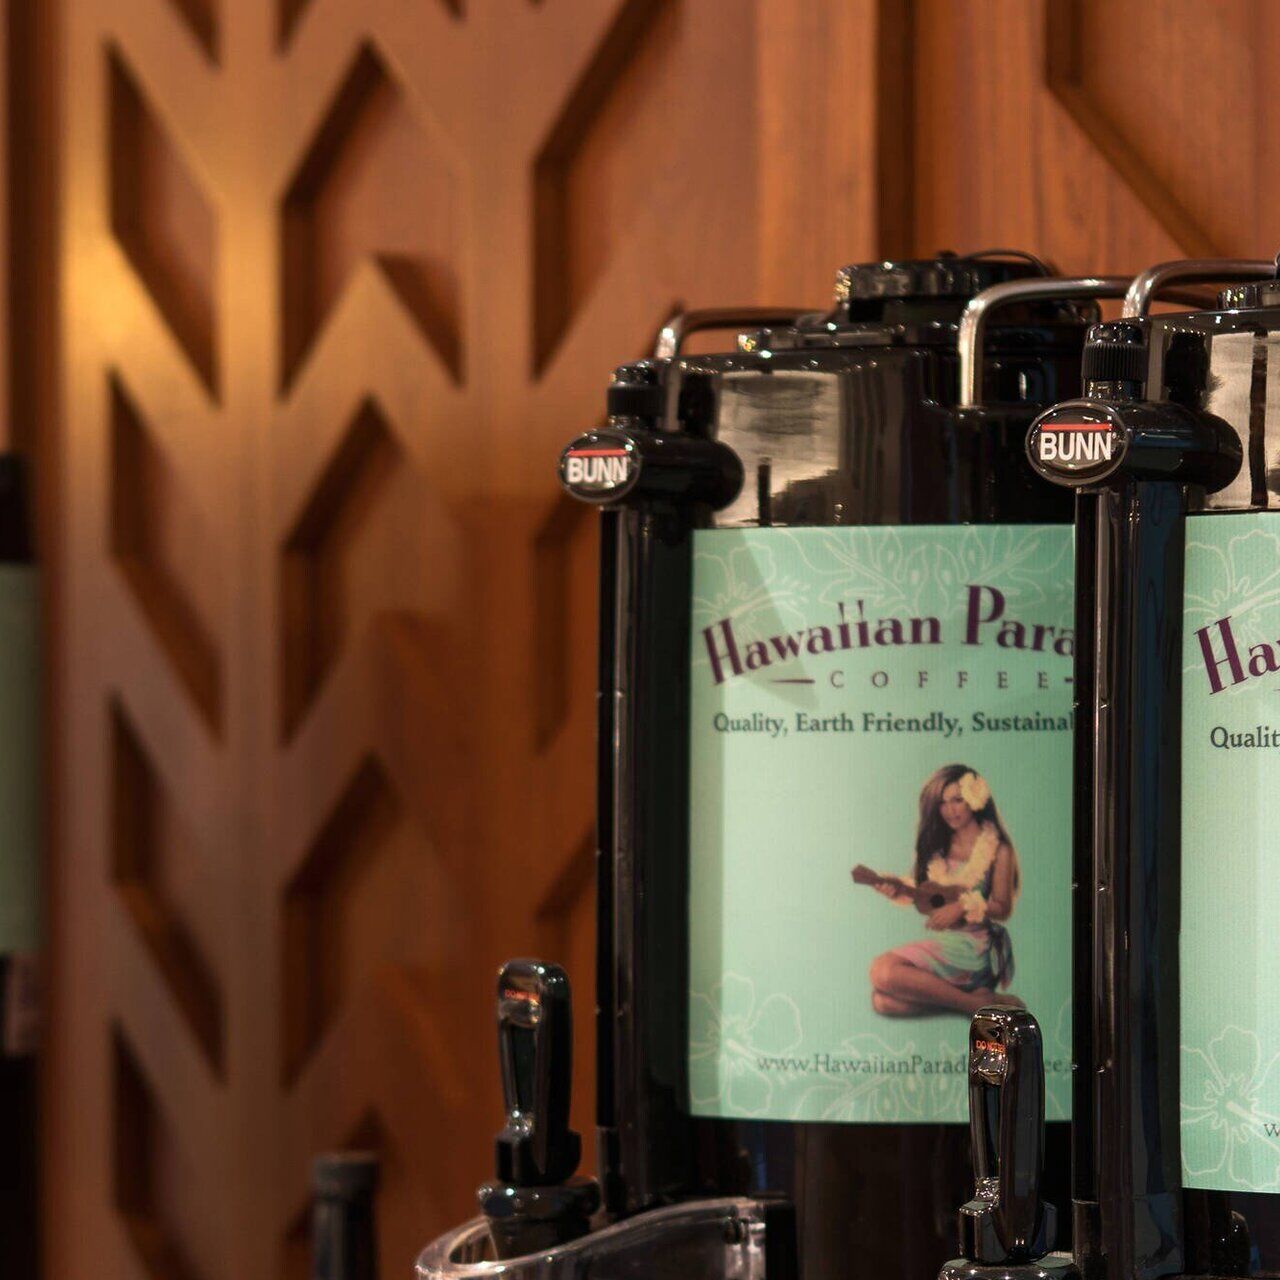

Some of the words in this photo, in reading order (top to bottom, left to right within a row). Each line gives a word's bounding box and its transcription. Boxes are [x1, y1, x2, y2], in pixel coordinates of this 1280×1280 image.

[1040, 432, 1111, 460] BUNN
[567, 456, 627, 483] BUNN
[701, 600, 942, 686] Hawaiian
[830, 671, 1048, 688] COFFEE
[713, 713, 788, 738] Quality,
[796, 713, 853, 732] Earth
[863, 712, 963, 738] Friendly,
